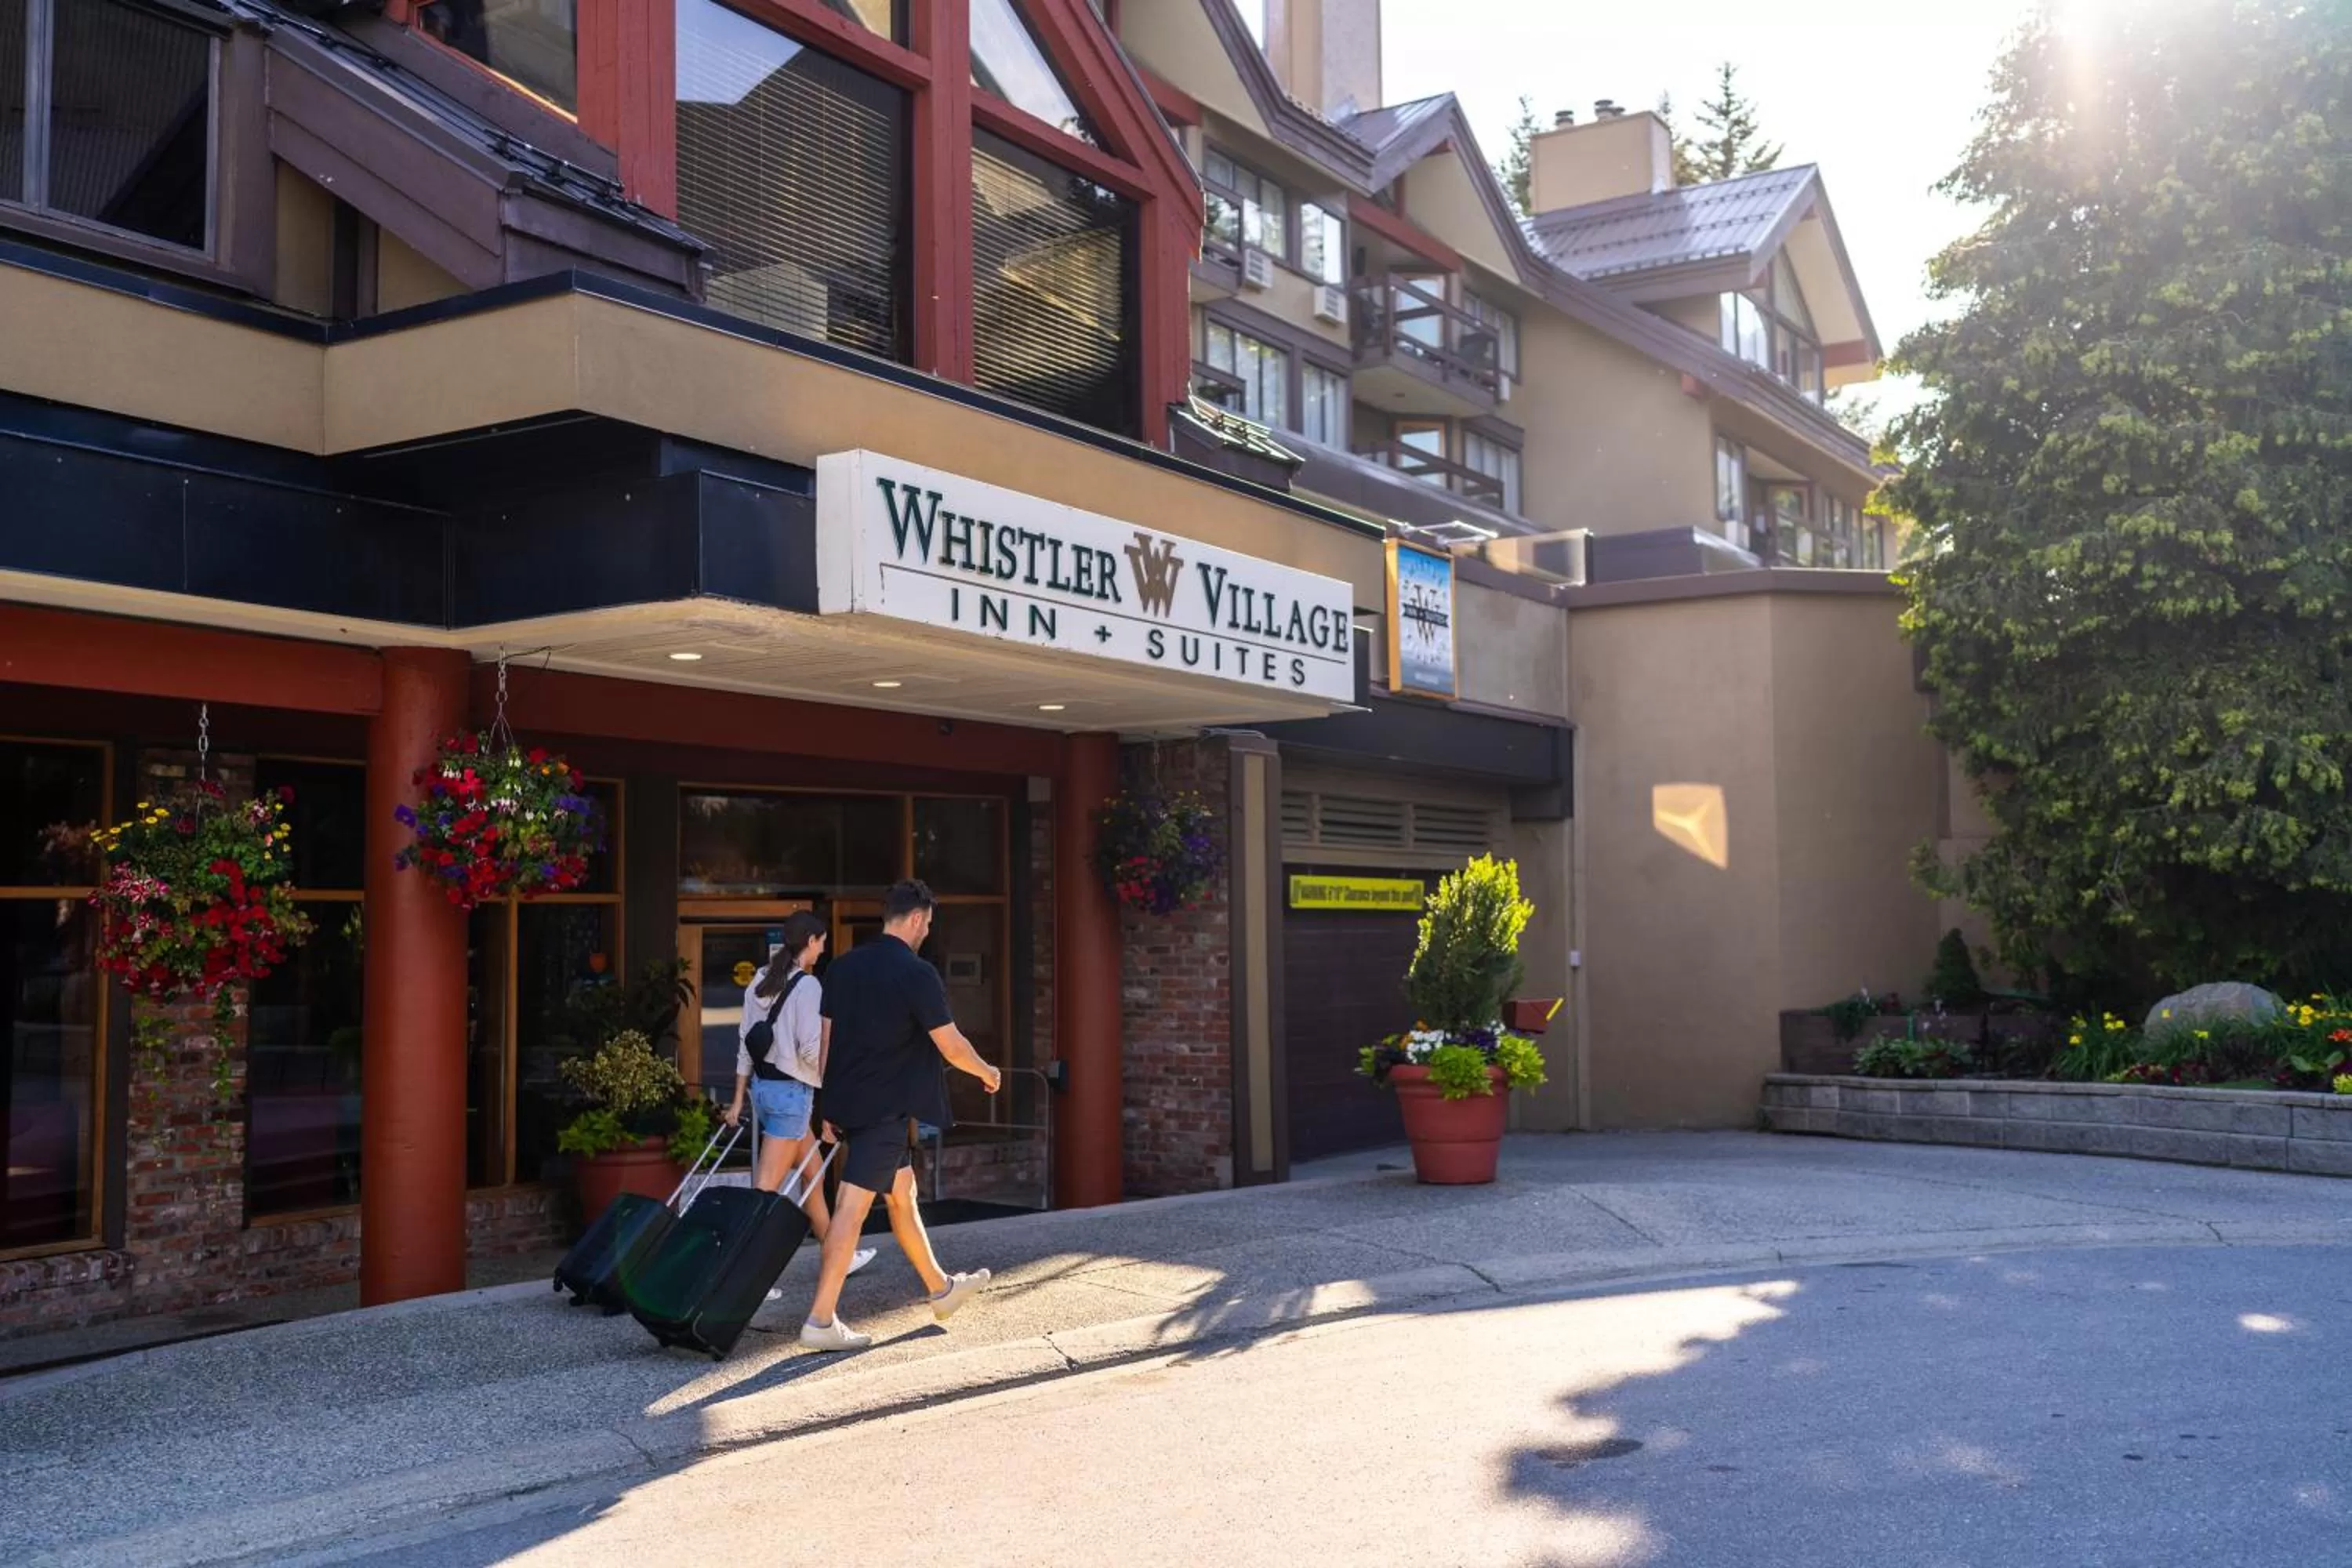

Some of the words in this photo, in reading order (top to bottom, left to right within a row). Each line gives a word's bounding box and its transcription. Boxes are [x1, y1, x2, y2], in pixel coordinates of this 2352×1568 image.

[877, 477, 1122, 603] WHISTLER
[1196, 562, 1348, 653] VILLAGE
[951, 588, 1057, 640] INN
[1094, 625, 1112, 643] +
[1146, 629, 1305, 686] SUITES
